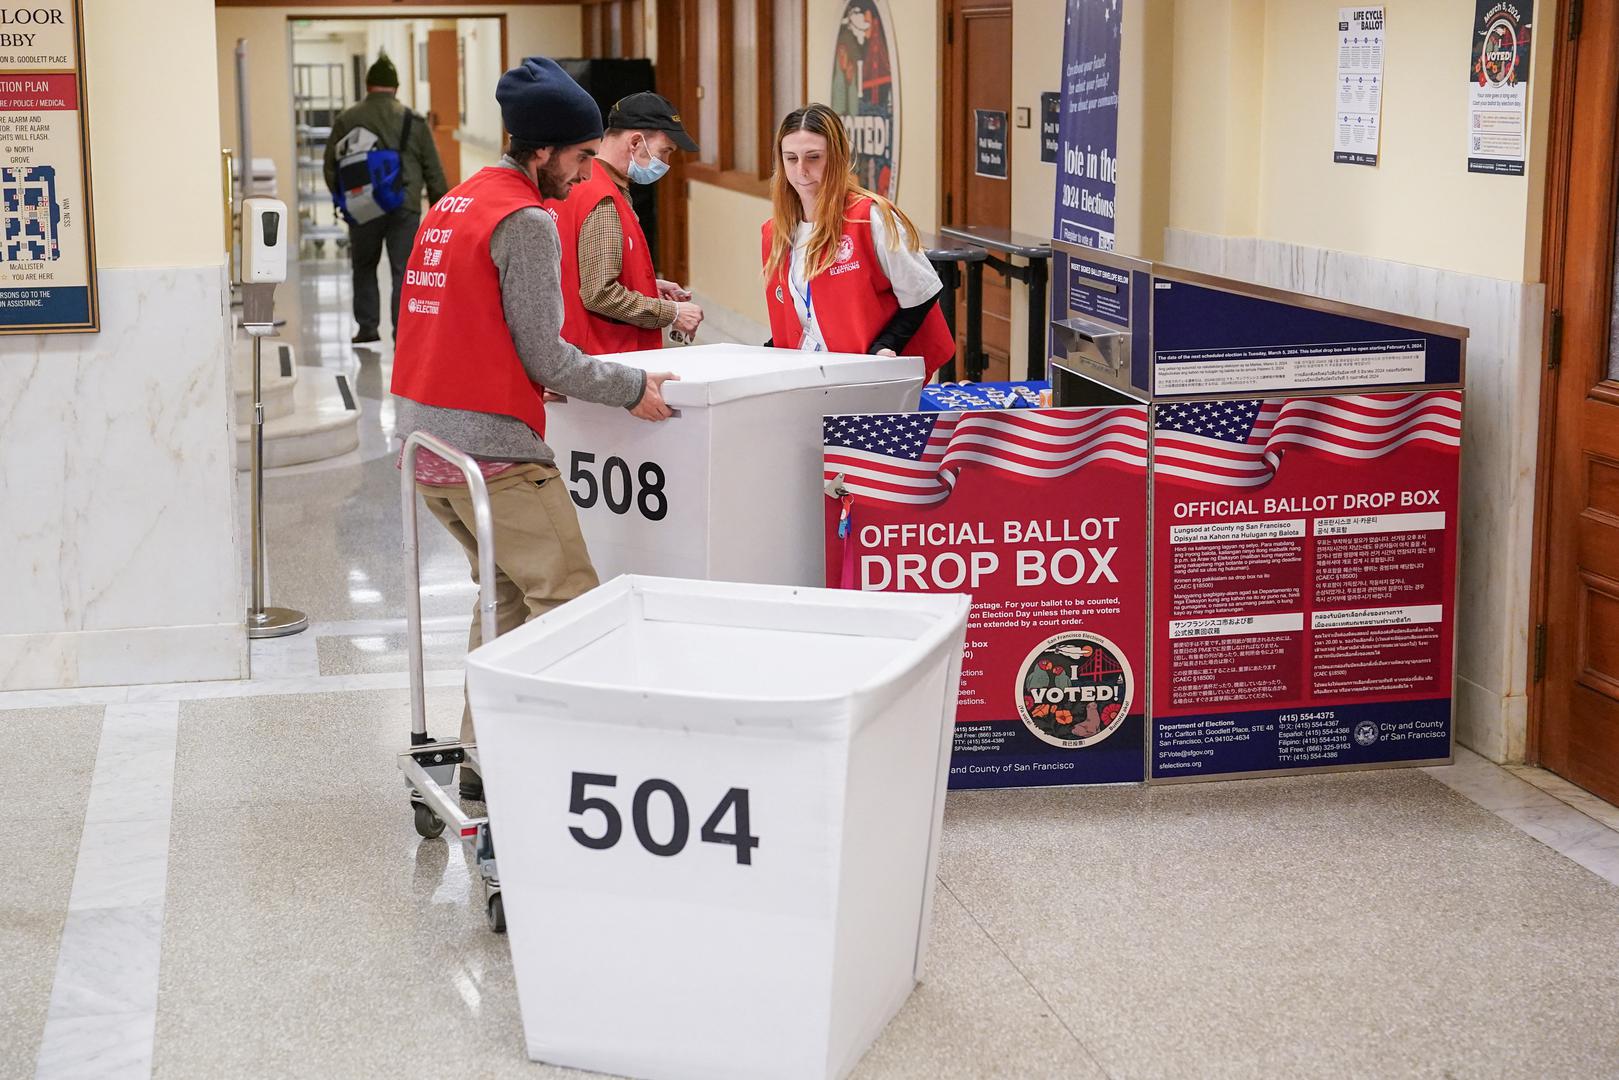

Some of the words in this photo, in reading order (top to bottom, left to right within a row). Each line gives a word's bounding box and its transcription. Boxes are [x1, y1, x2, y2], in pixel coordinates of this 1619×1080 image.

[1354, 11, 1364, 20] LIFE
[1365, 10, 1383, 20] CYCLE
[1484, 4, 1501, 23] March
[1508, 4, 1520, 22] 2024
[1361, 20, 1383, 30] BALLOT
[0, 34, 36, 46] BBY
[17, 56, 48, 64] GOODLETT
[49, 56, 67, 64] PLACE
[1487, 51, 1512, 60] VOTED!
[857, 60, 863, 98] I
[25, 81, 48, 92] PLAN
[13, 99, 34, 107] POLICE
[10, 156, 30, 164] GROVE
[1087, 144, 1097, 180] in
[1100, 148, 1117, 184] the
[423, 248, 442, 266] 投票
[40, 290, 50, 298] THE
[7, 299, 44, 307] ASSISTANCE.
[1248, 350, 1268, 358] Tuesday,
[1386, 343, 1406, 351] February
[569, 450, 668, 521] 508
[1173, 499, 1259, 518] OFFICIAL
[1264, 495, 1338, 514] BALLOT
[1343, 492, 1396, 510] DROP
[1400, 489, 1440, 506] BOX
[859, 522, 994, 548] OFFICIAL
[1003, 517, 1120, 544] BALLOT
[1174, 526, 1203, 535] Lungsod
[1211, 524, 1234, 533] County
[1259, 521, 1291, 529] Francisco
[1174, 534, 1198, 543] Opisyal
[1241, 530, 1268, 539] Hulugan
[860, 551, 1000, 591] DROP
[1016, 546, 1120, 587] BOX
[970, 602, 1003, 610] postage.
[1020, 601, 1039, 609] your
[1040, 599, 1062, 607] ballot
[1075, 598, 1085, 606] be
[1086, 597, 1120, 605] counted,
[1015, 610, 1031, 619] Day
[1032, 609, 1058, 617] unless
[1060, 608, 1080, 616] there
[983, 620, 1018, 628] extended
[1020, 619, 1031, 628] by
[1057, 632, 1082, 641] Francisco
[1082, 632, 1105, 644] Elections
[1070, 665, 1078, 680] I
[1031, 685, 1119, 704] VOTED!
[1278, 714, 1298, 723] (415)
[1300, 712, 1334, 720] 554-4375
[1159, 722, 1196, 731] Department
[1205, 720, 1234, 728] Elections
[1380, 722, 1397, 732] City
[1398, 721, 1414, 730] and
[1415, 720, 1444, 730] County
[1174, 730, 1196, 738] Carlton
[1205, 727, 1231, 735] Goodlett
[1231, 726, 1250, 734] Place,
[1380, 733, 1390, 742] of
[1390, 732, 1406, 740] San
[1407, 730, 1446, 740] Francisco
[1159, 749, 1214, 758] SFVote@sfgov.org
[951, 765, 966, 774] and
[969, 764, 1000, 774] County
[1003, 763, 1013, 772] of
[1014, 763, 1030, 772] San
[1032, 761, 1074, 771] Francisco
[1159, 761, 1202, 770] sfelections.org
[568, 771, 760, 866] 504
